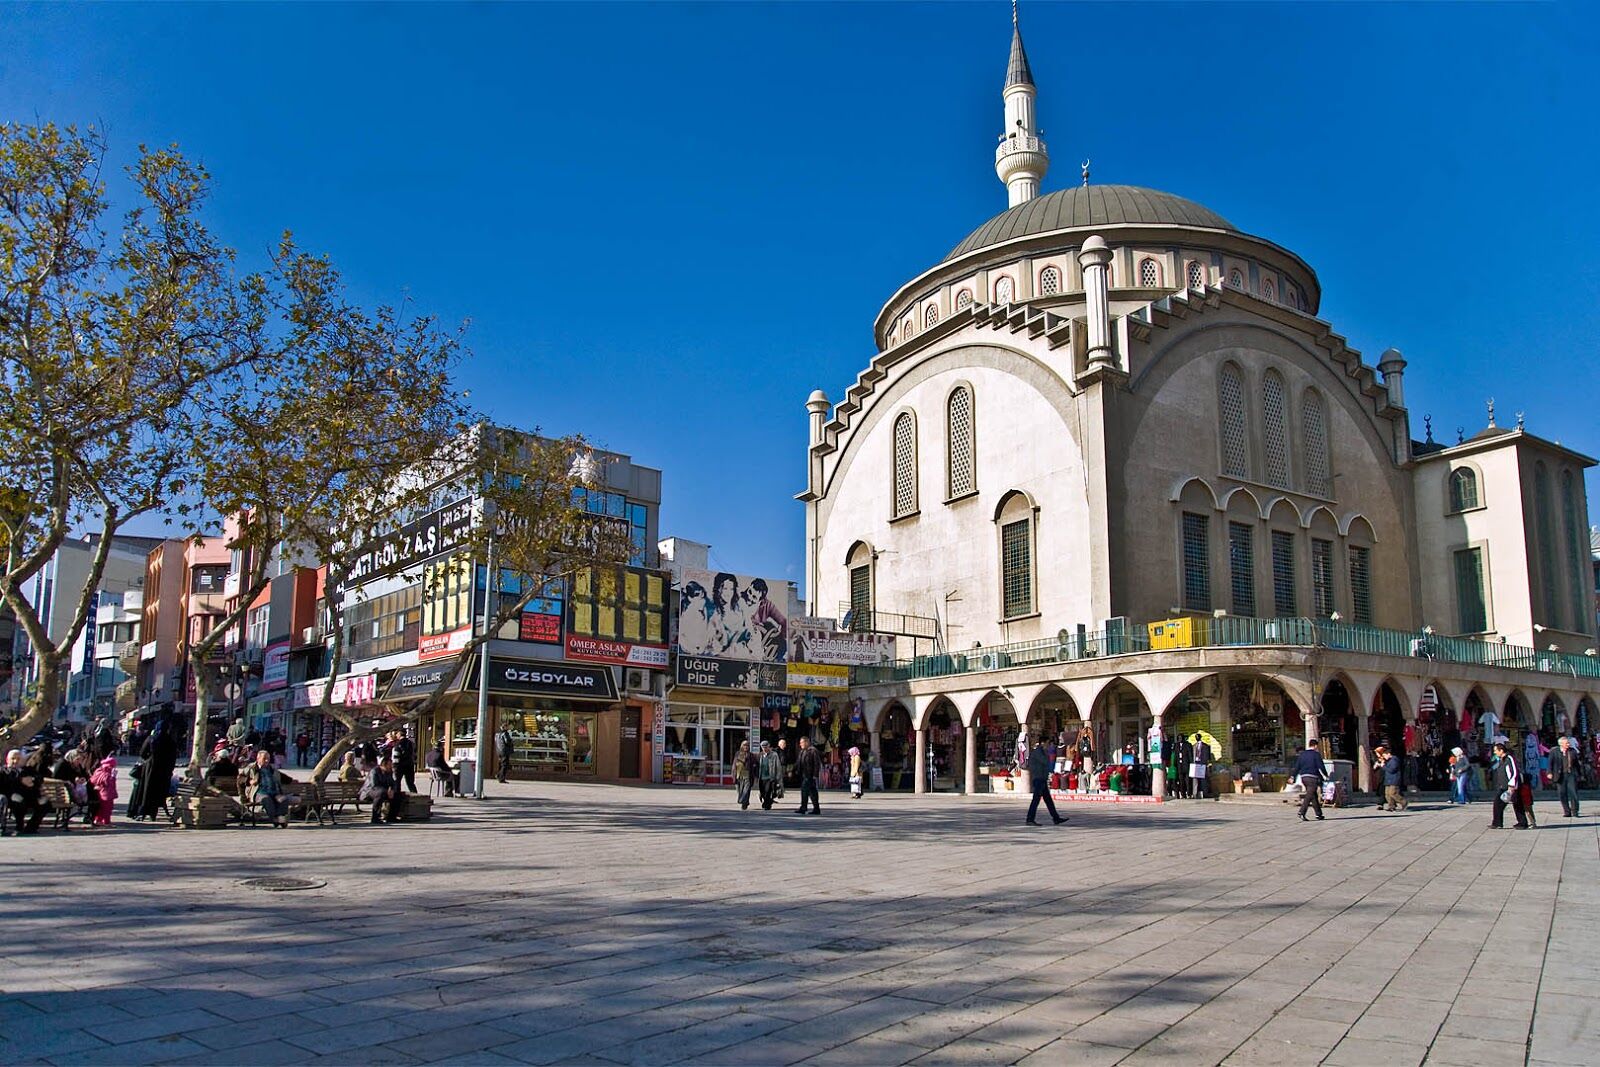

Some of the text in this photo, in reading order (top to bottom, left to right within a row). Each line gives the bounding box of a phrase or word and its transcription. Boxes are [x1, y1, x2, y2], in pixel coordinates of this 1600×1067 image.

[570, 638, 626, 653] ÖMER ASLAN
[684, 658, 720, 672] UĞUR
[401, 672, 442, 686] ÖZSOYLAR
[505, 668, 594, 687] ÖZSOYLAR
[687, 672, 716, 685] PİDE
